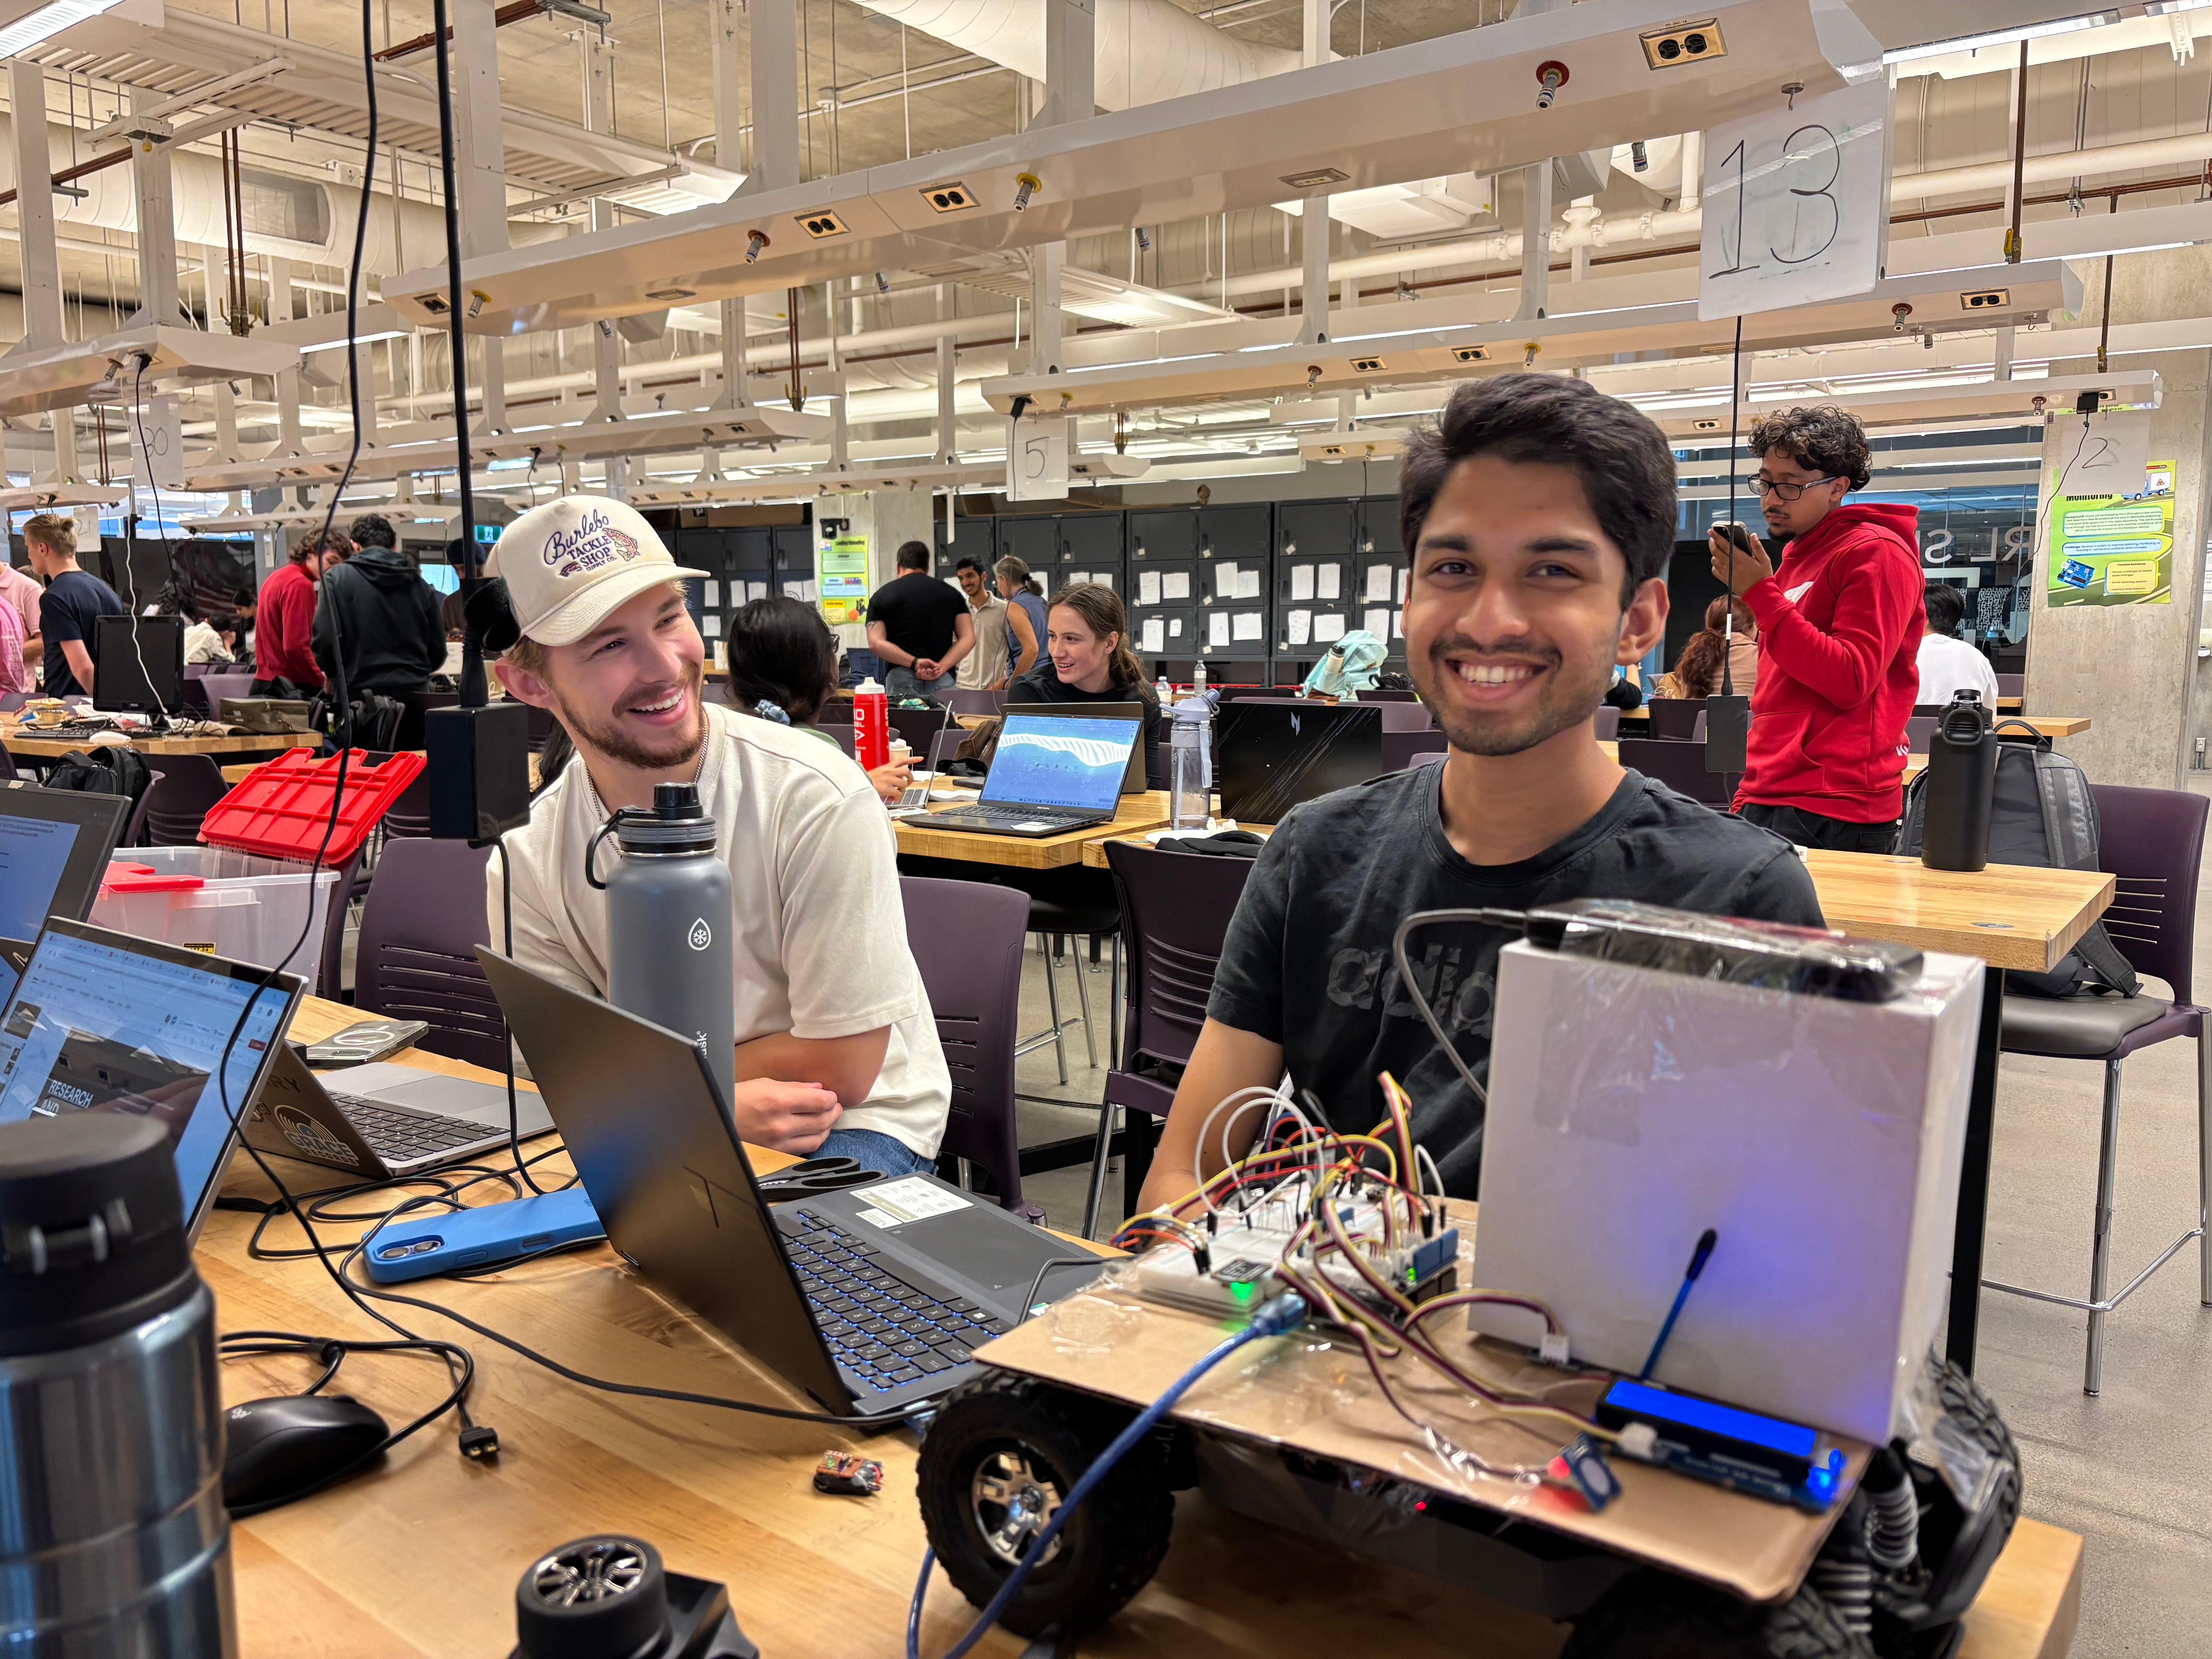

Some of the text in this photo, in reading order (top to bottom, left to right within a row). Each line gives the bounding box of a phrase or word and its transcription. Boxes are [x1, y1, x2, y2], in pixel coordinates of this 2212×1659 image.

[1708, 124, 1839, 279] 13
[1025, 436, 1050, 478] 5
[2082, 437, 2113, 469] 2
[544, 509, 609, 565] Burlebo
[567, 536, 611, 560] TACKLE
[579, 547, 611, 567] SHOP
[586, 560, 606, 572] SUPPLY
[41, 1099, 59, 1113] AND
[48, 1080, 94, 1108] RESEARCH
[286, 1133, 357, 1159] GRACE
[303, 1148, 357, 1165] RECORDS
